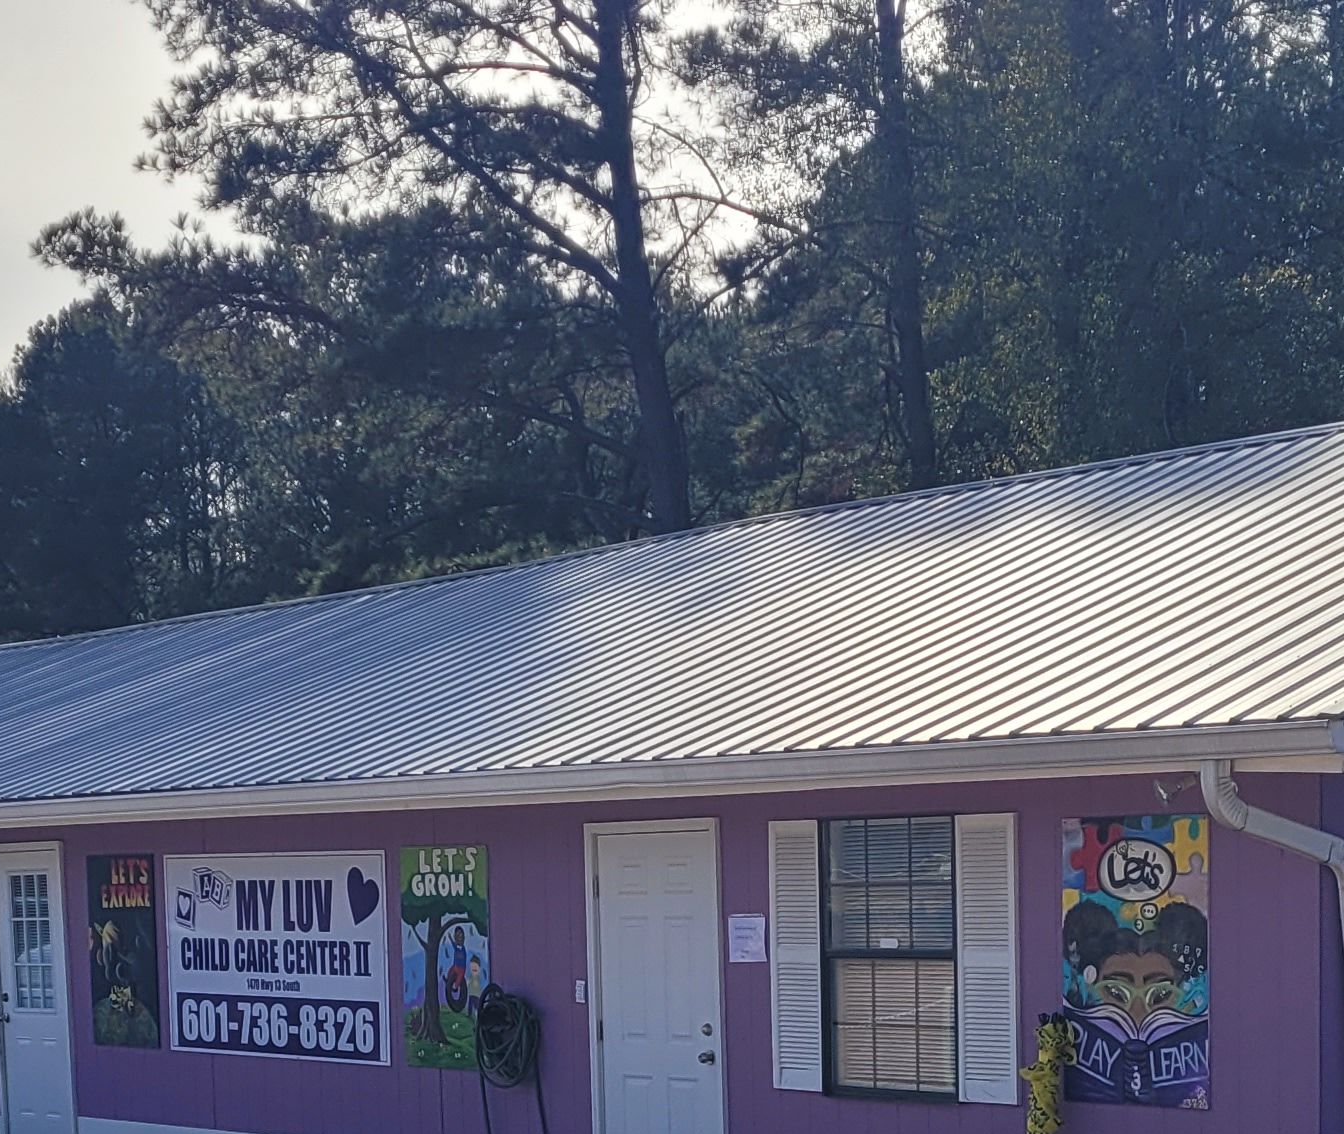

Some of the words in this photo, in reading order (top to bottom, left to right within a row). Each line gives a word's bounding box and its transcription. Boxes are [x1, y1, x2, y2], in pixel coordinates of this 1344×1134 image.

[419, 847, 477, 873] LET'S
[1107, 850, 1164, 890] Let's
[411, 872, 473, 897] GROW!
[236, 880, 275, 931] MY
[282, 880, 333, 932] LUV
[181, 937, 229, 971] CHILD
[234, 938, 279, 973] CARE
[283, 939, 351, 976] CENTER
[353, 941, 371, 977] II
[282, 979, 301, 992] South
[182, 998, 375, 1053] 601-736-8326
[1149, 1040, 1209, 1081] LEARN
